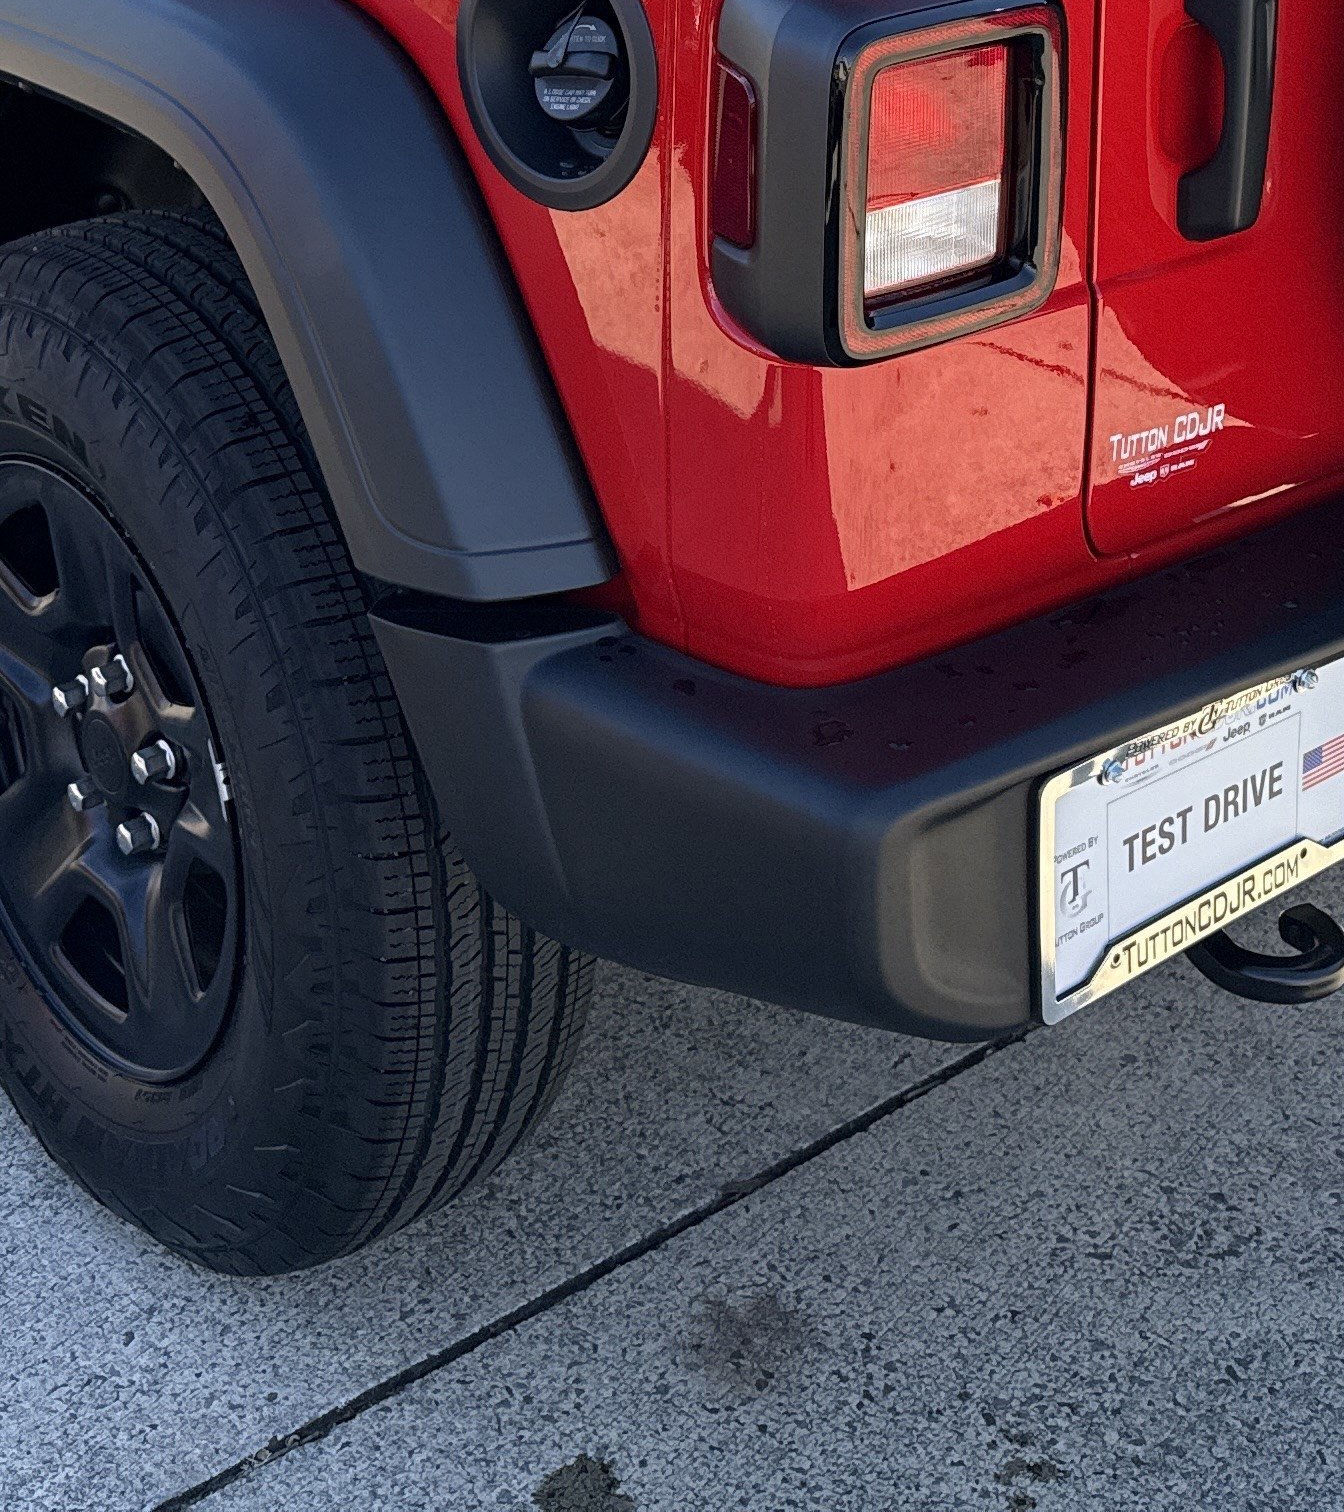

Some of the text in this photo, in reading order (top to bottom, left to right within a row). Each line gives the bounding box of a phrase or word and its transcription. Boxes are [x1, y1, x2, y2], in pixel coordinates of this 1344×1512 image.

[1109, 424, 1169, 462] TUTTON
[1173, 403, 1226, 444] CDJR
[1223, 721, 1251, 742] Jeep
[1123, 760, 1284, 873] TEST DRIVE
[1054, 927, 1079, 948] UTTON
